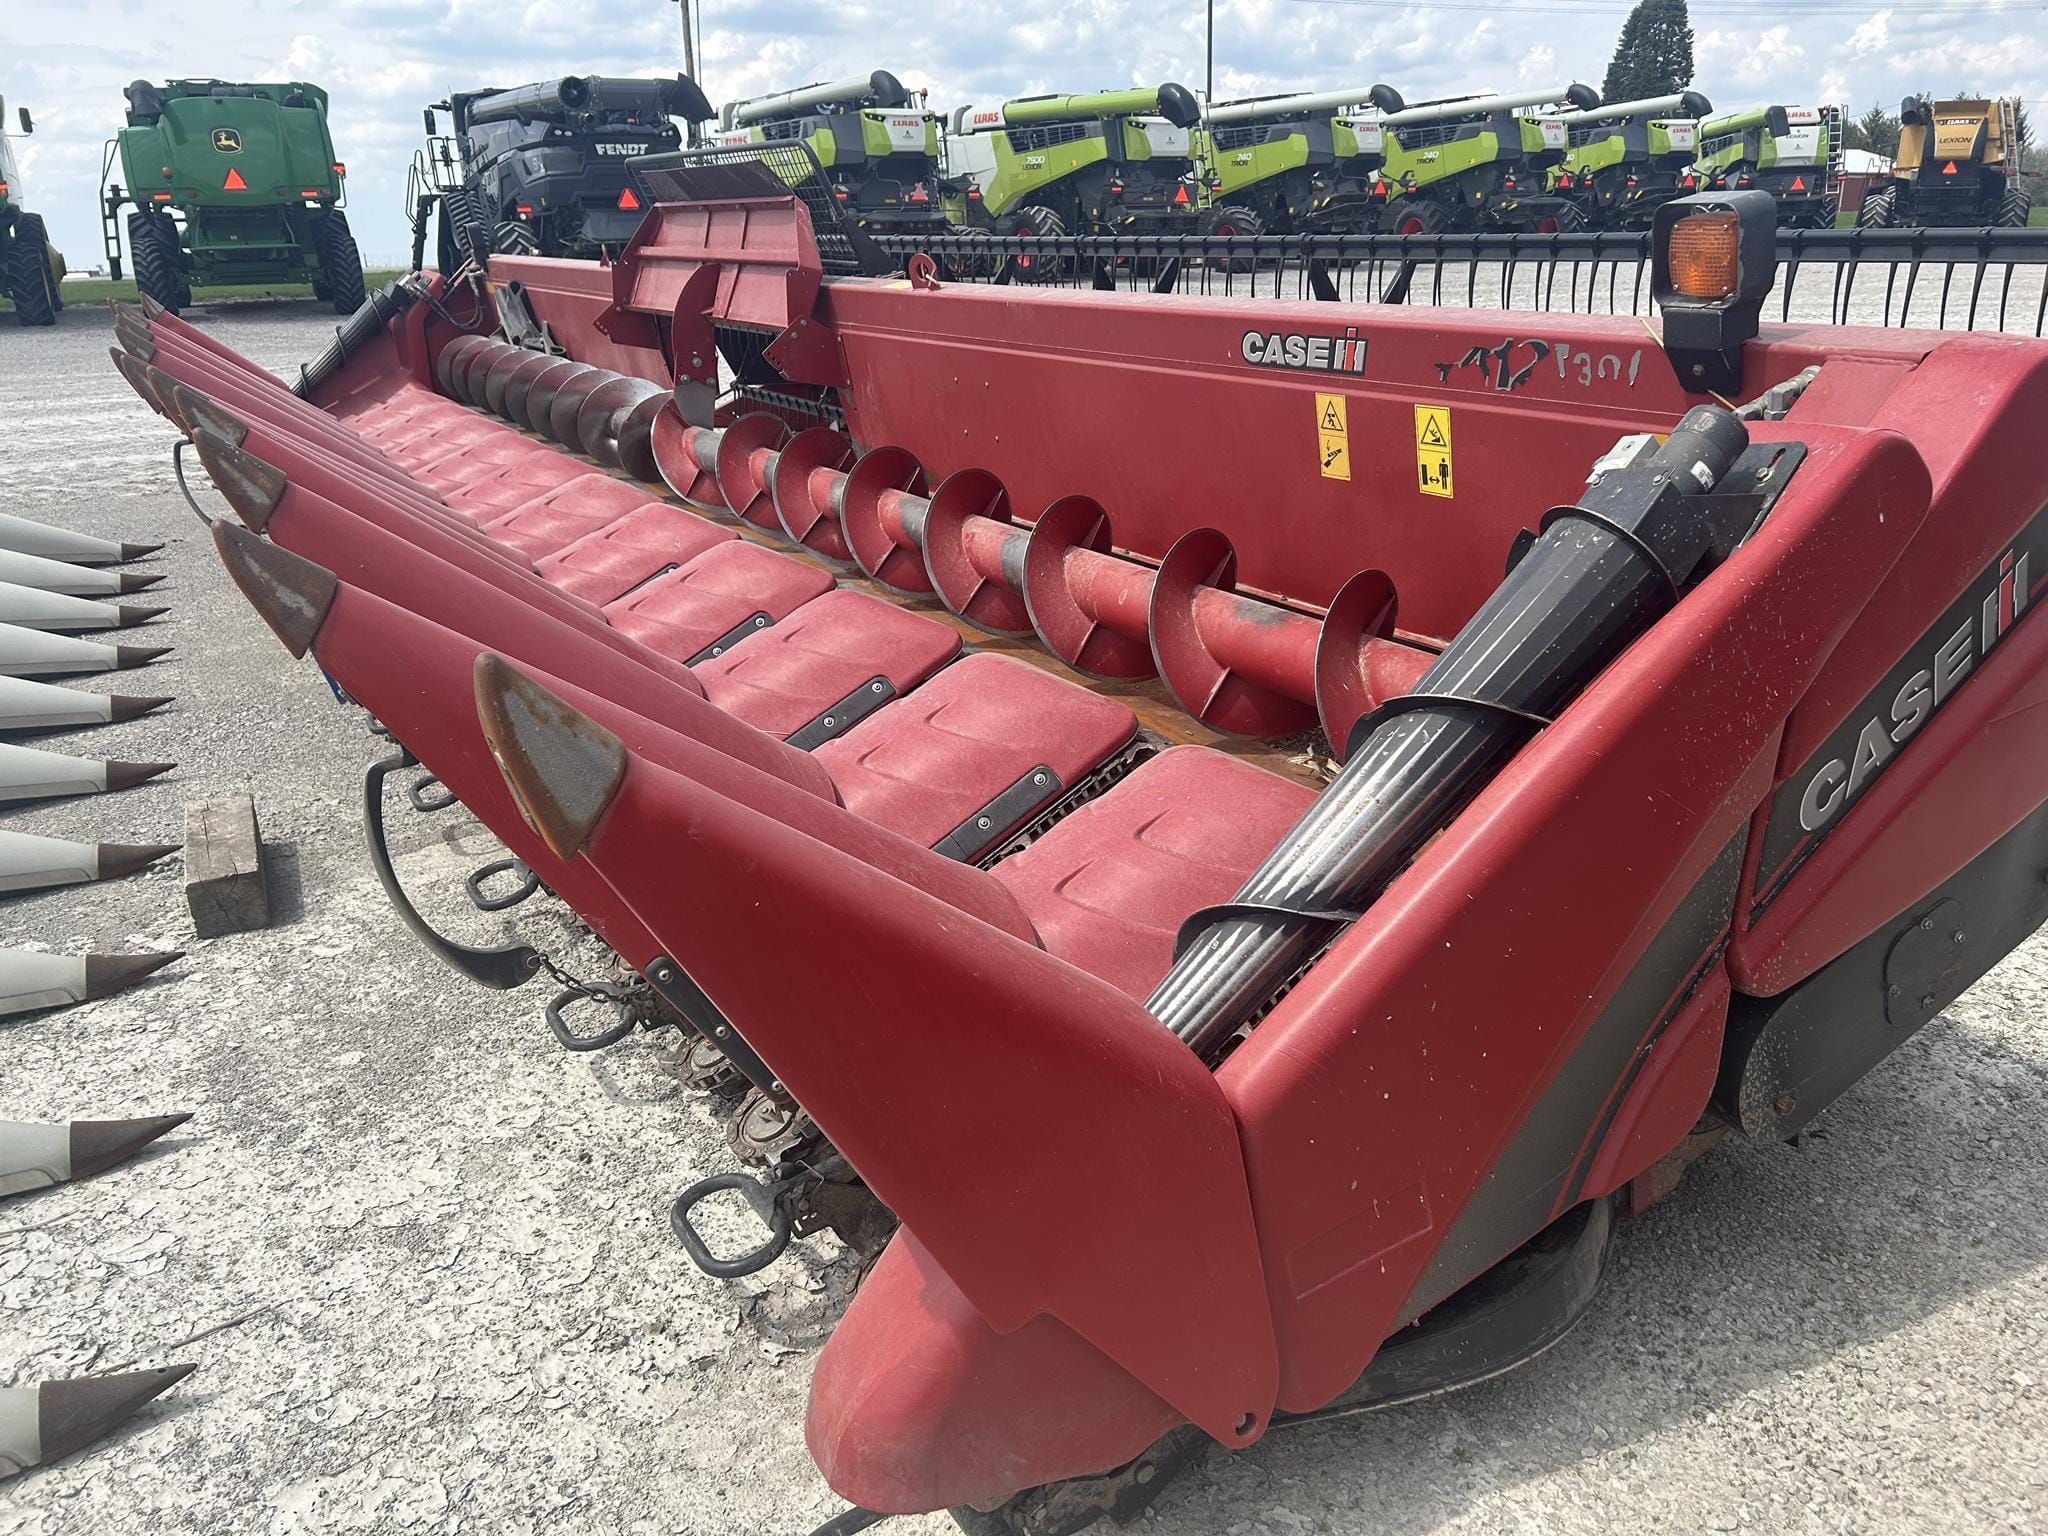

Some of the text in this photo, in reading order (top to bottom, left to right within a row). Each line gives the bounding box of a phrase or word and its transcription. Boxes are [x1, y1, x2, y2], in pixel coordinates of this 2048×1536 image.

[892, 119, 920, 127] CLAAS
[974, 112, 999, 125] CLAAS
[595, 143, 649, 156] FENDT
[1025, 155, 1046, 165] 7500
[1242, 331, 1331, 370] CASE
[1799, 616, 1974, 832] CASE
